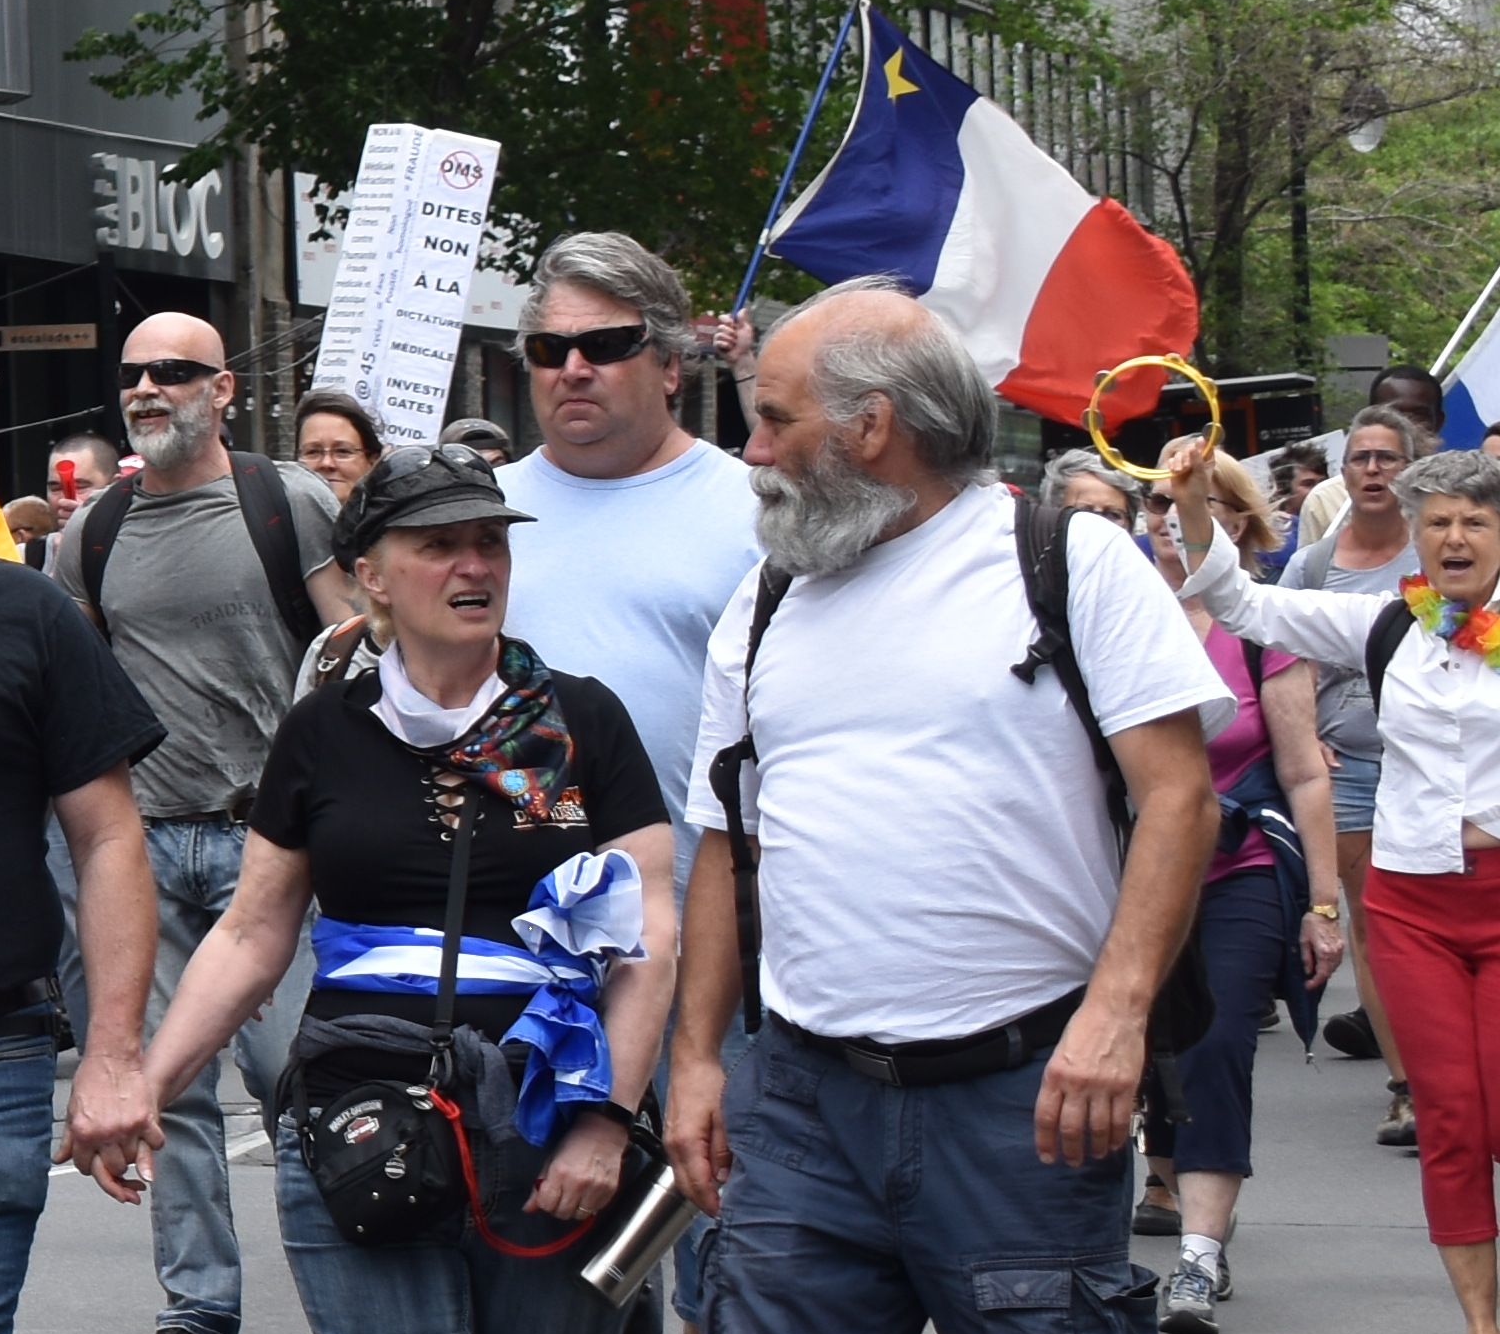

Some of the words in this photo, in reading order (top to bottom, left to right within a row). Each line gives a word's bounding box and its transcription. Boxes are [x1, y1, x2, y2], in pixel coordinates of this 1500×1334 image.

[441, 159, 483, 180] OMS
[118, 157, 225, 259] BLOC
[422, 201, 483, 226] DITES
[423, 235, 470, 257] NON
[435, 278, 461, 296] LA
[396, 308, 463, 330] DICTATURE
[390, 341, 456, 363] MÉDICALE
[360, 351, 377, 376] 45
[386, 377, 446, 399] INVESTI
[387, 396, 434, 415] GATES
[384, 424, 427, 441] OVID-
